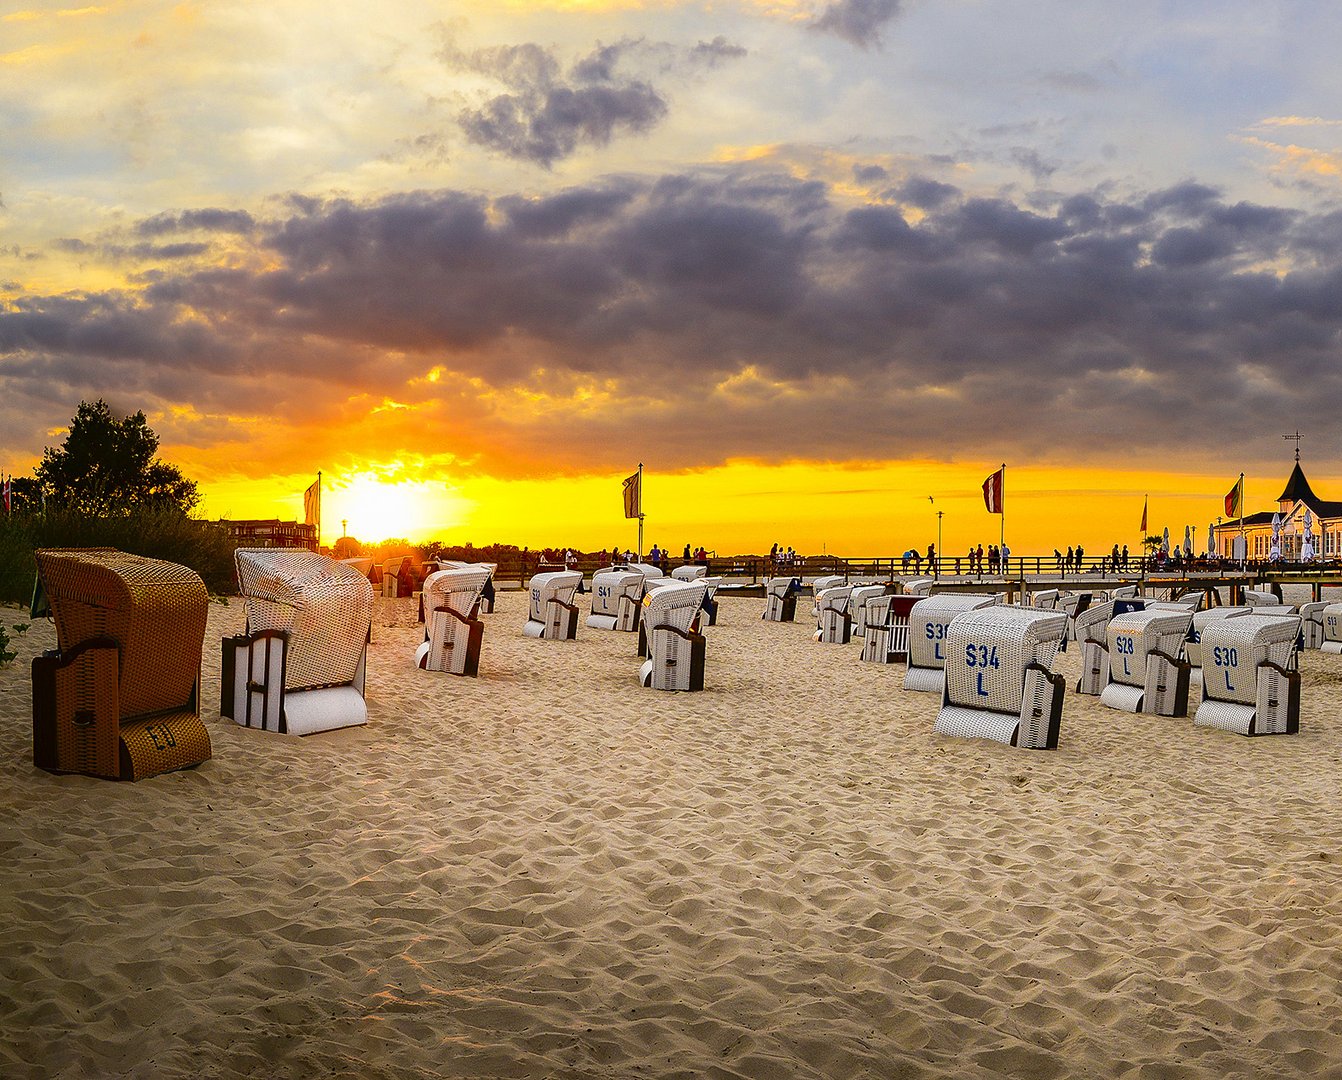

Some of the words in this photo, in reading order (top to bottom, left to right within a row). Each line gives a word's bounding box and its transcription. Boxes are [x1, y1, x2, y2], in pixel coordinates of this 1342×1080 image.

[603, 598, 609, 610] L
[935, 643, 944, 659] L
[1116, 635, 1134, 655] S28
[966, 643, 999, 669] S34
[1213, 646, 1238, 667] S30
[1124, 657, 1131, 675] L
[977, 672, 989, 696] L
[1225, 671, 1234, 690] L
